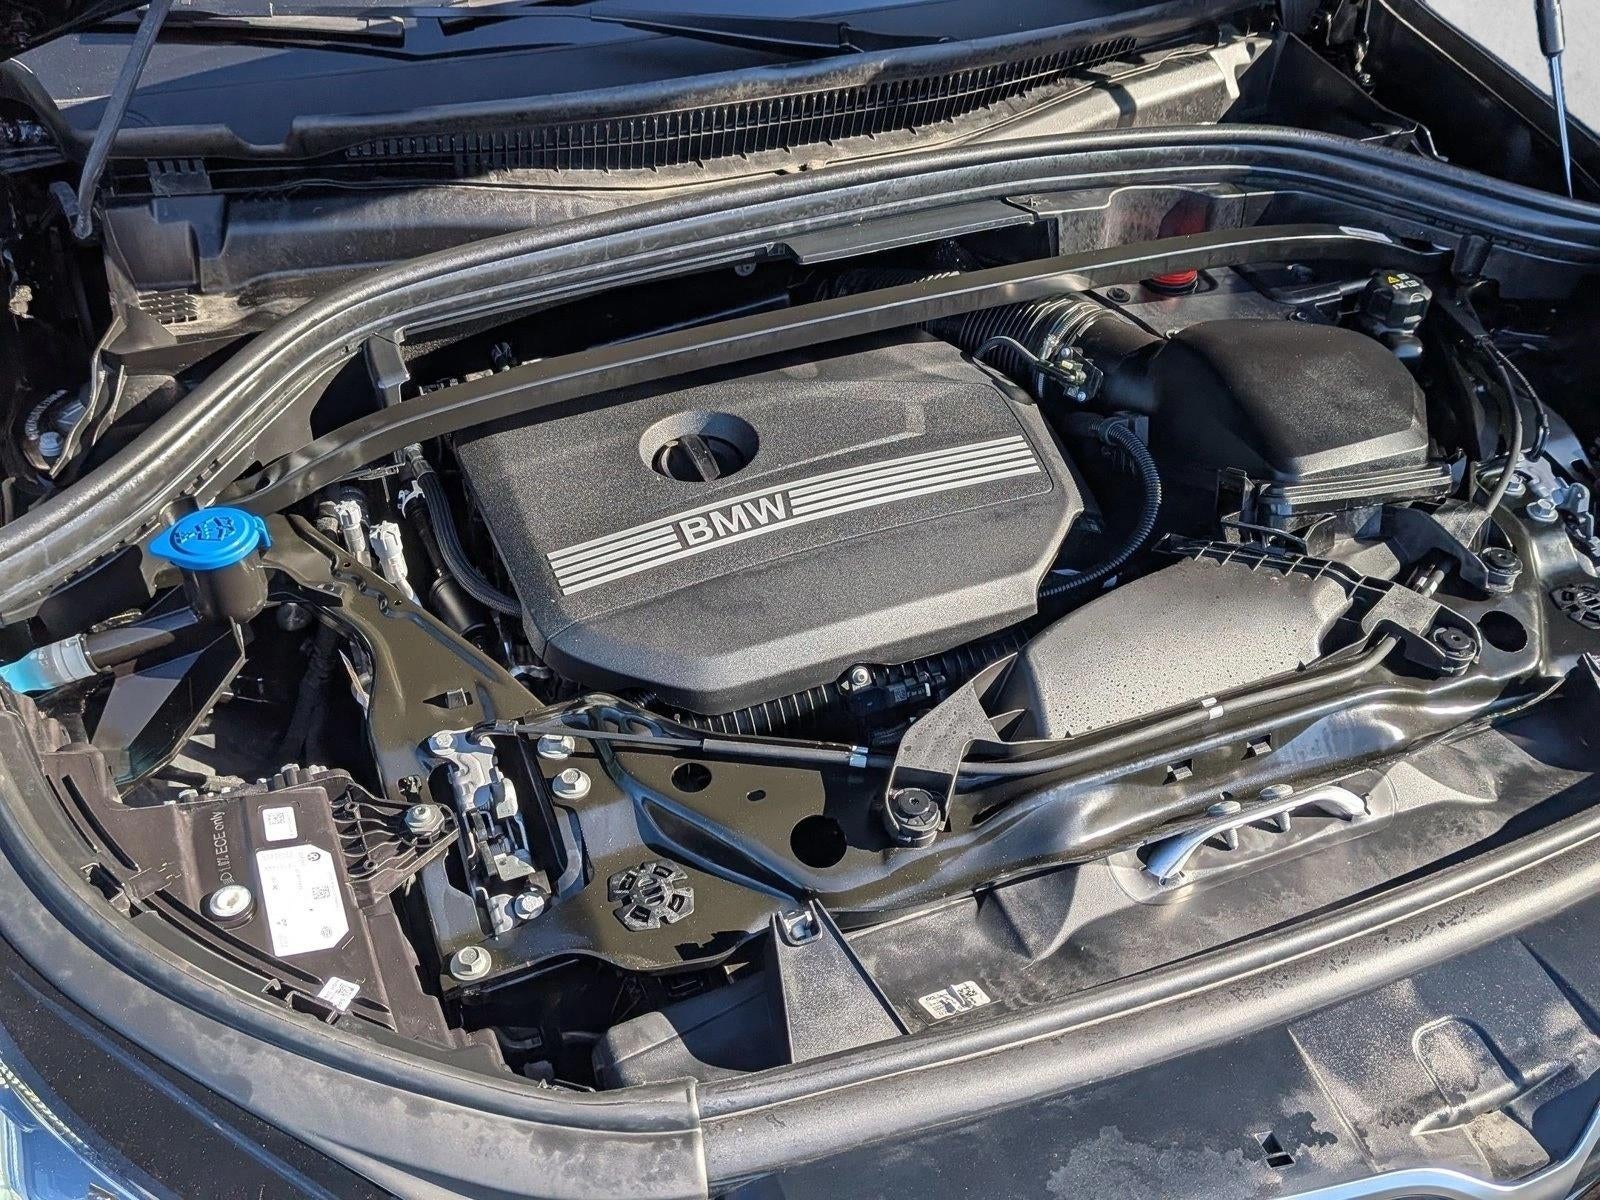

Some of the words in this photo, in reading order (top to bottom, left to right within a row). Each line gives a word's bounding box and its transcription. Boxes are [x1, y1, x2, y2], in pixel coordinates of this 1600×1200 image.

[679, 493, 786, 546] BMW
[210, 811, 226, 831] only
[213, 831, 228, 855] ECE
